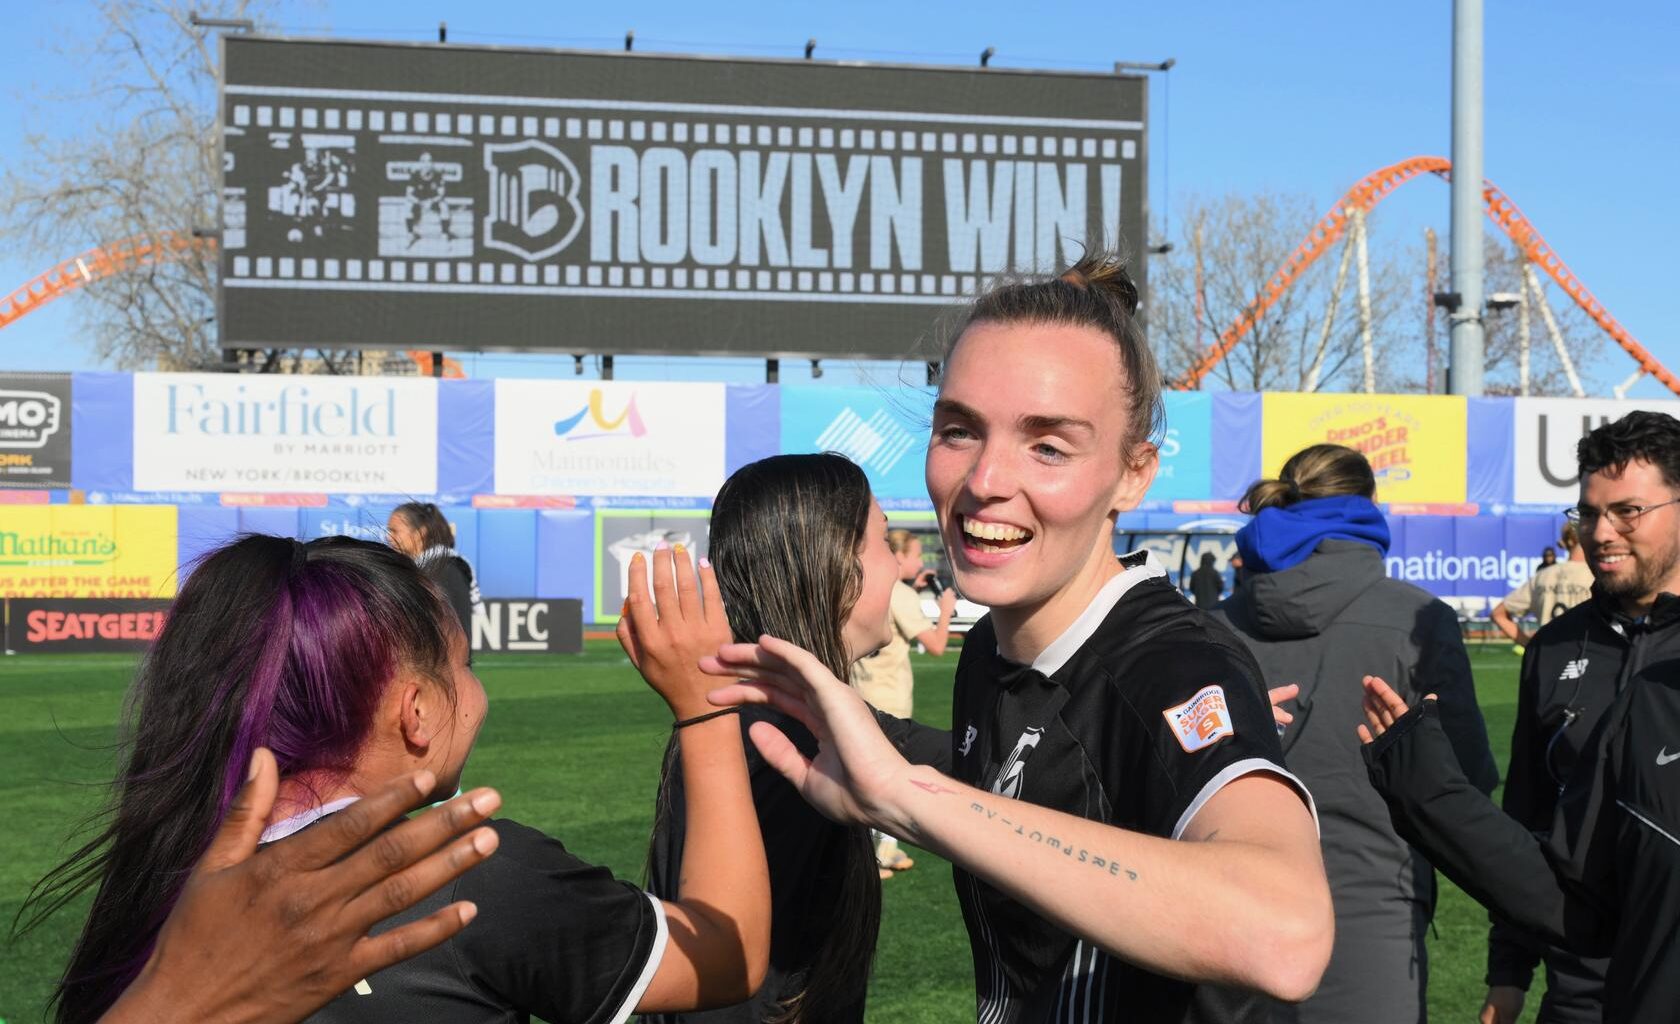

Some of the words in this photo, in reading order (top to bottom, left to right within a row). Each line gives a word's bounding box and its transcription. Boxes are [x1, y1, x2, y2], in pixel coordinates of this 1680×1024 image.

[165, 384, 399, 437] Fairfield
[1326, 416, 1388, 443] DENO'S
[1350, 426, 1409, 455] NDER
[274, 444, 292, 455] BY
[301, 444, 399, 456] MARRIOTT
[530, 449, 677, 472] Maimonides
[185, 468, 227, 482] NEW
[0, 531, 116, 556] Nathan's
[18, 576, 68, 588] AFTER
[73, 576, 101, 587] THE
[108, 576, 152, 587] GAME
[508, 602, 549, 641] FC
[1180, 695, 1224, 728] SUPER
